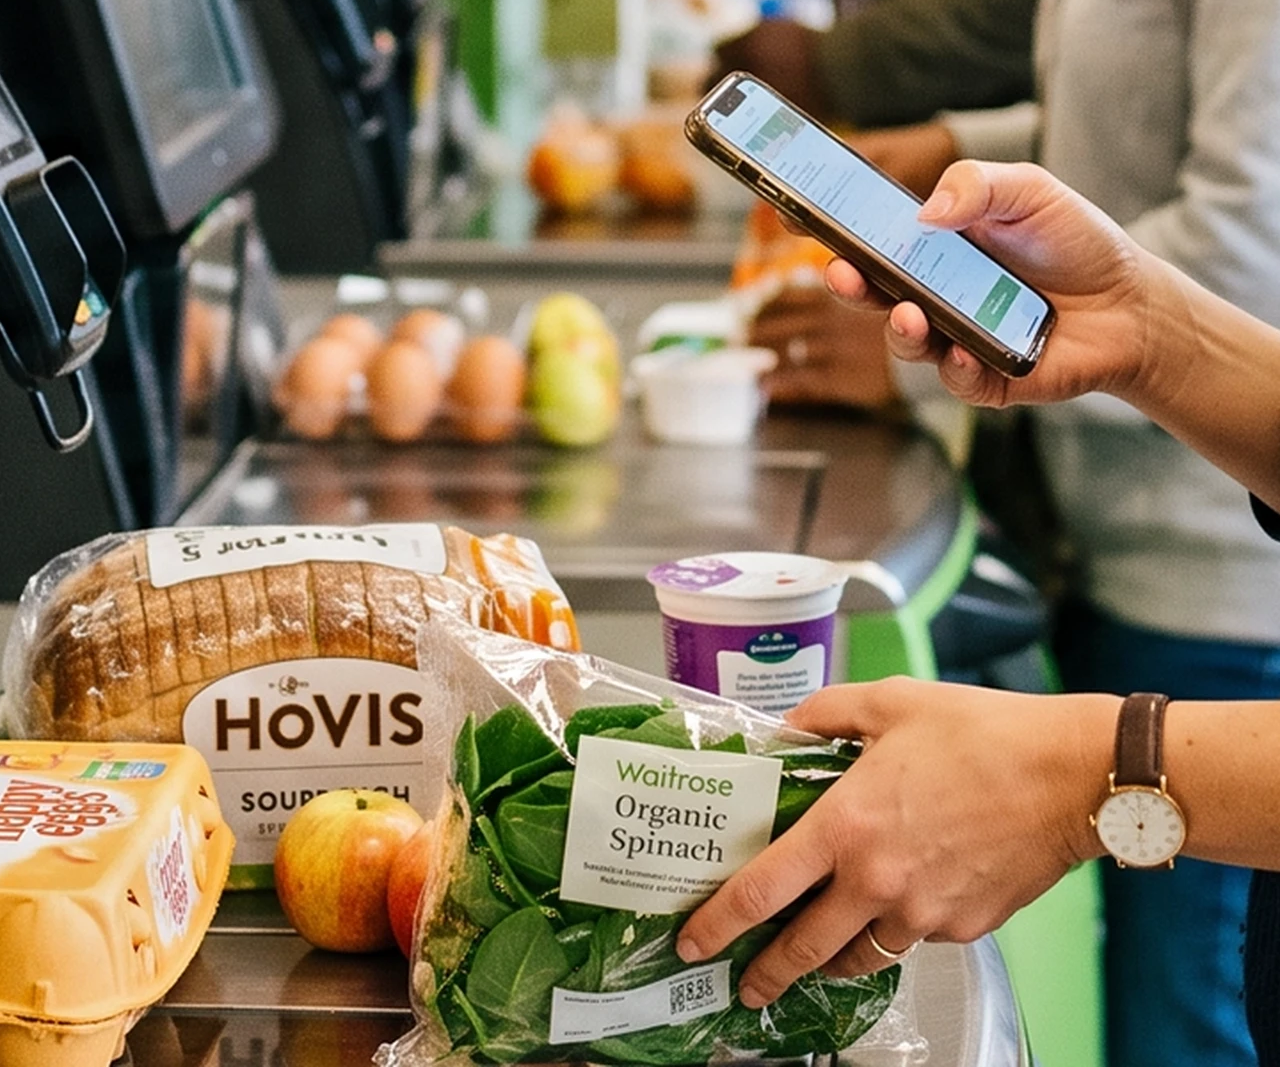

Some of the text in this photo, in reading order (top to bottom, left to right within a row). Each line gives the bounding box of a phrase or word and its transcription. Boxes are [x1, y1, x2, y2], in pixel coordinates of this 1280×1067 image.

[616, 759, 734, 797] Waitrose
[615, 794, 728, 830] Organic
[609, 827, 724, 863] Spinach
